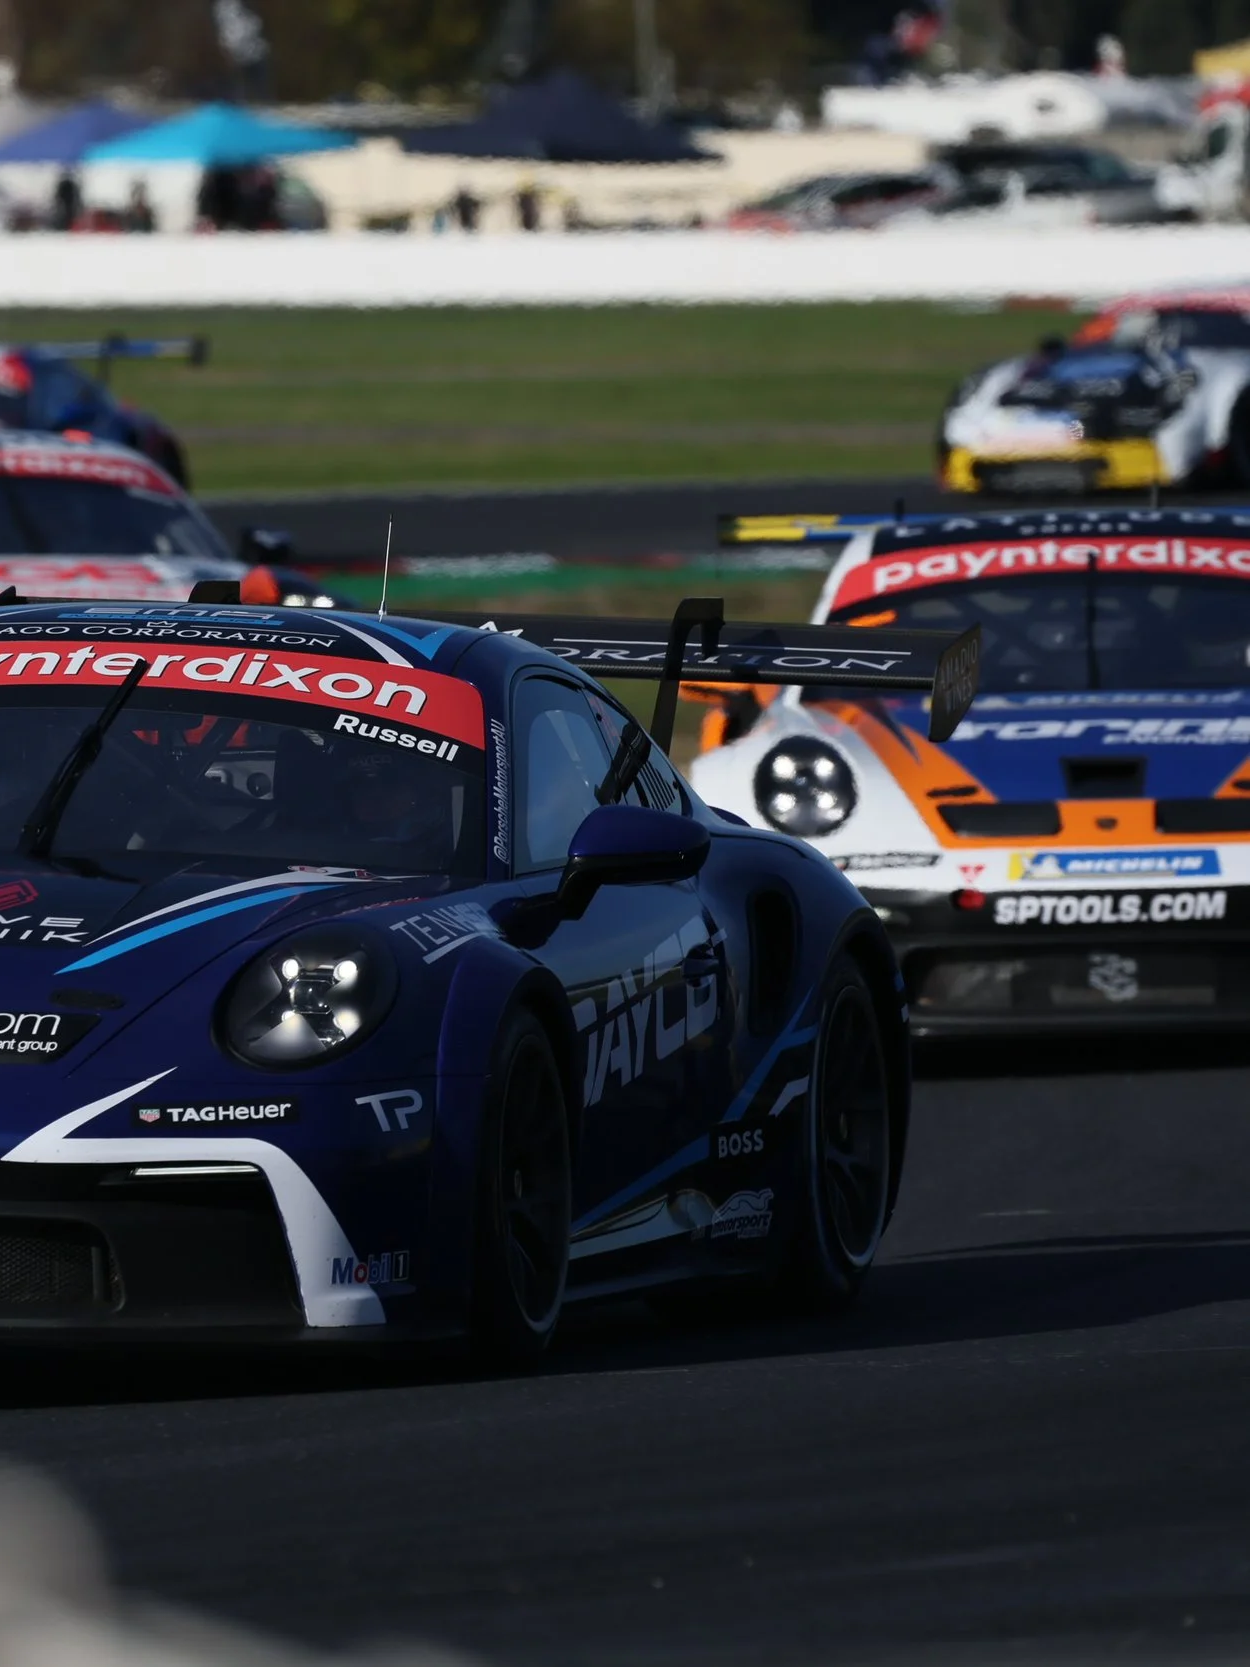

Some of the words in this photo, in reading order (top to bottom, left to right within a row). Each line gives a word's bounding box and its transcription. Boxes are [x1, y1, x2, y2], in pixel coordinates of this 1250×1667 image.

[82, 625, 337, 648] CORPORATION
[333, 713, 459, 761] Russell
[491, 718, 510, 865] @PorscheMotorsportAU
[1066, 855, 1203, 873] MICHELIN
[994, 891, 1227, 925] SPTOOLS.COM
[17, 1041, 58, 1054] group
[718, 1129, 765, 1159] BOSS
[331, 1252, 391, 1285] Mobil
[393, 1251, 409, 1281] 1
